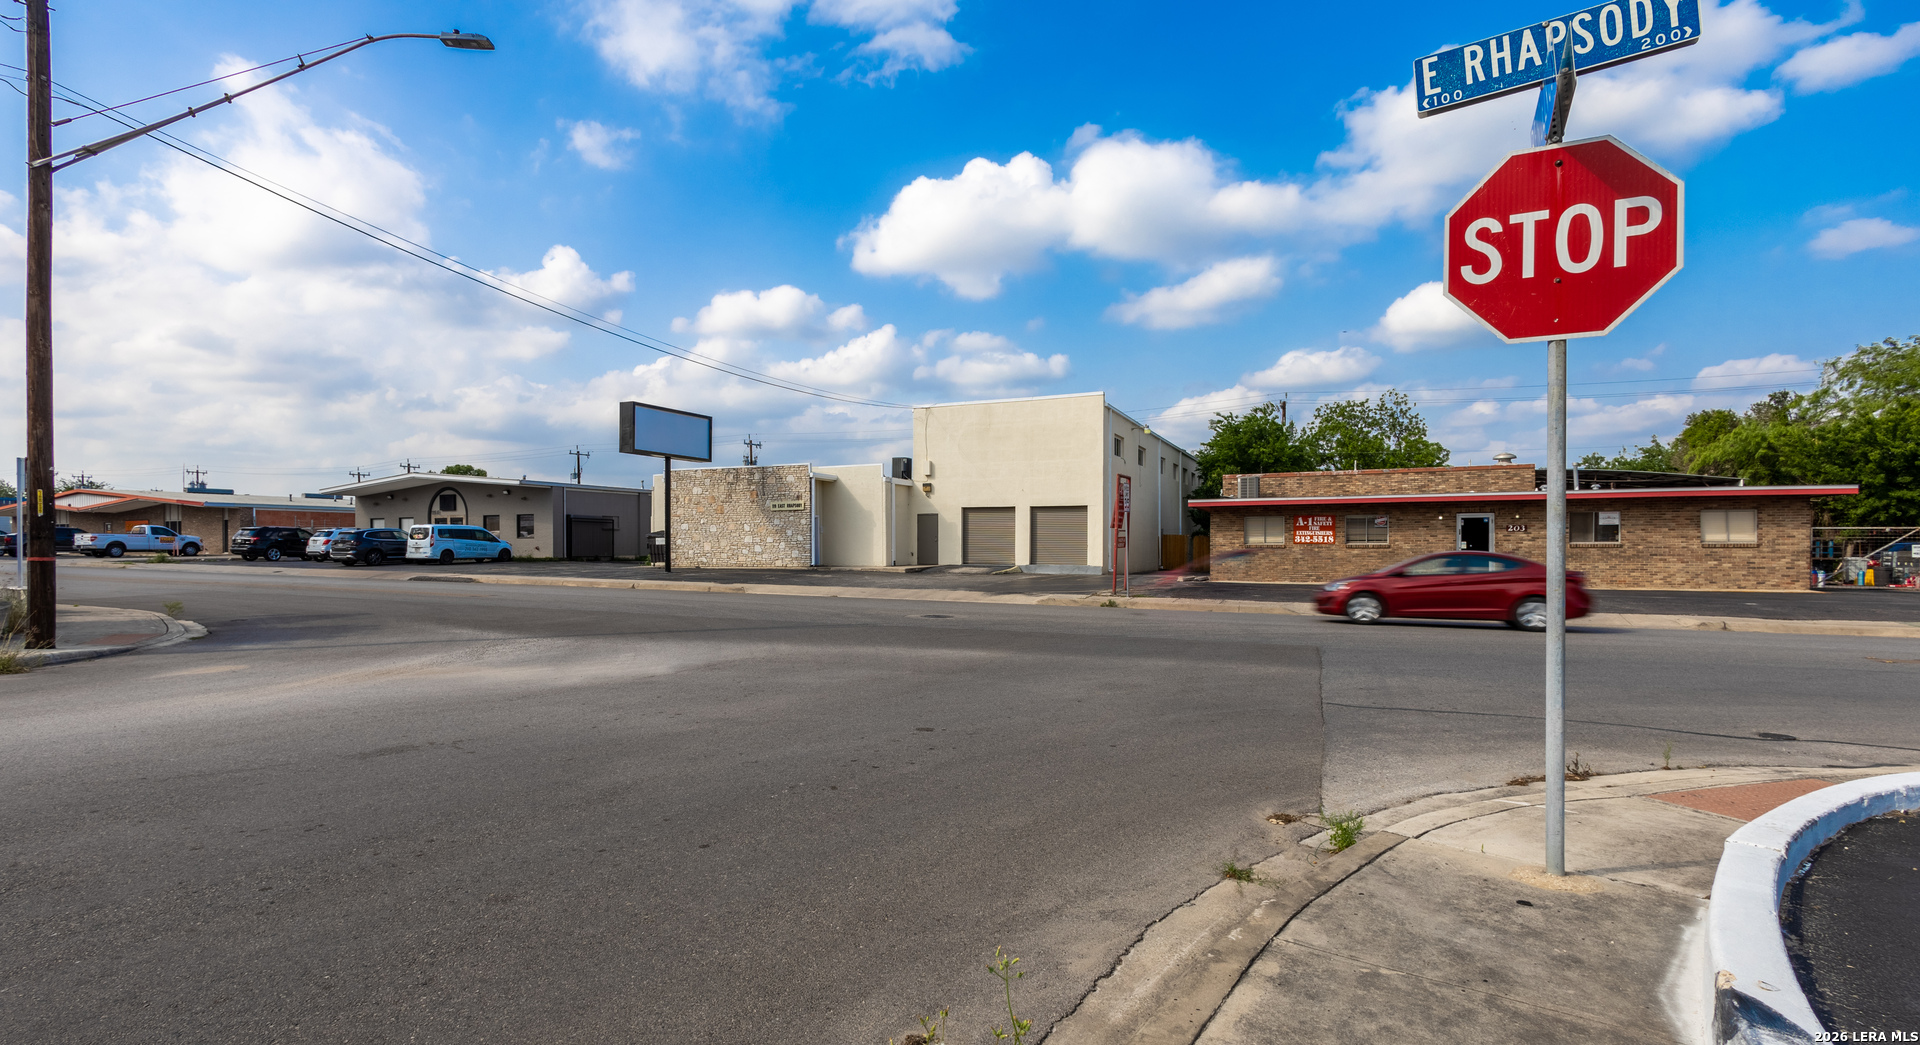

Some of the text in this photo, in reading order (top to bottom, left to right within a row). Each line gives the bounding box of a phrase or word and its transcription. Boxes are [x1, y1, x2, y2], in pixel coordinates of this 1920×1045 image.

[1422, 0, 1680, 96] E RHAPSODY
[1641, 29, 1681, 50] 200
[1433, 90, 1463, 106] 100
[1460, 195, 1663, 285] STOP
[1296, 516, 1312, 526] A-1
